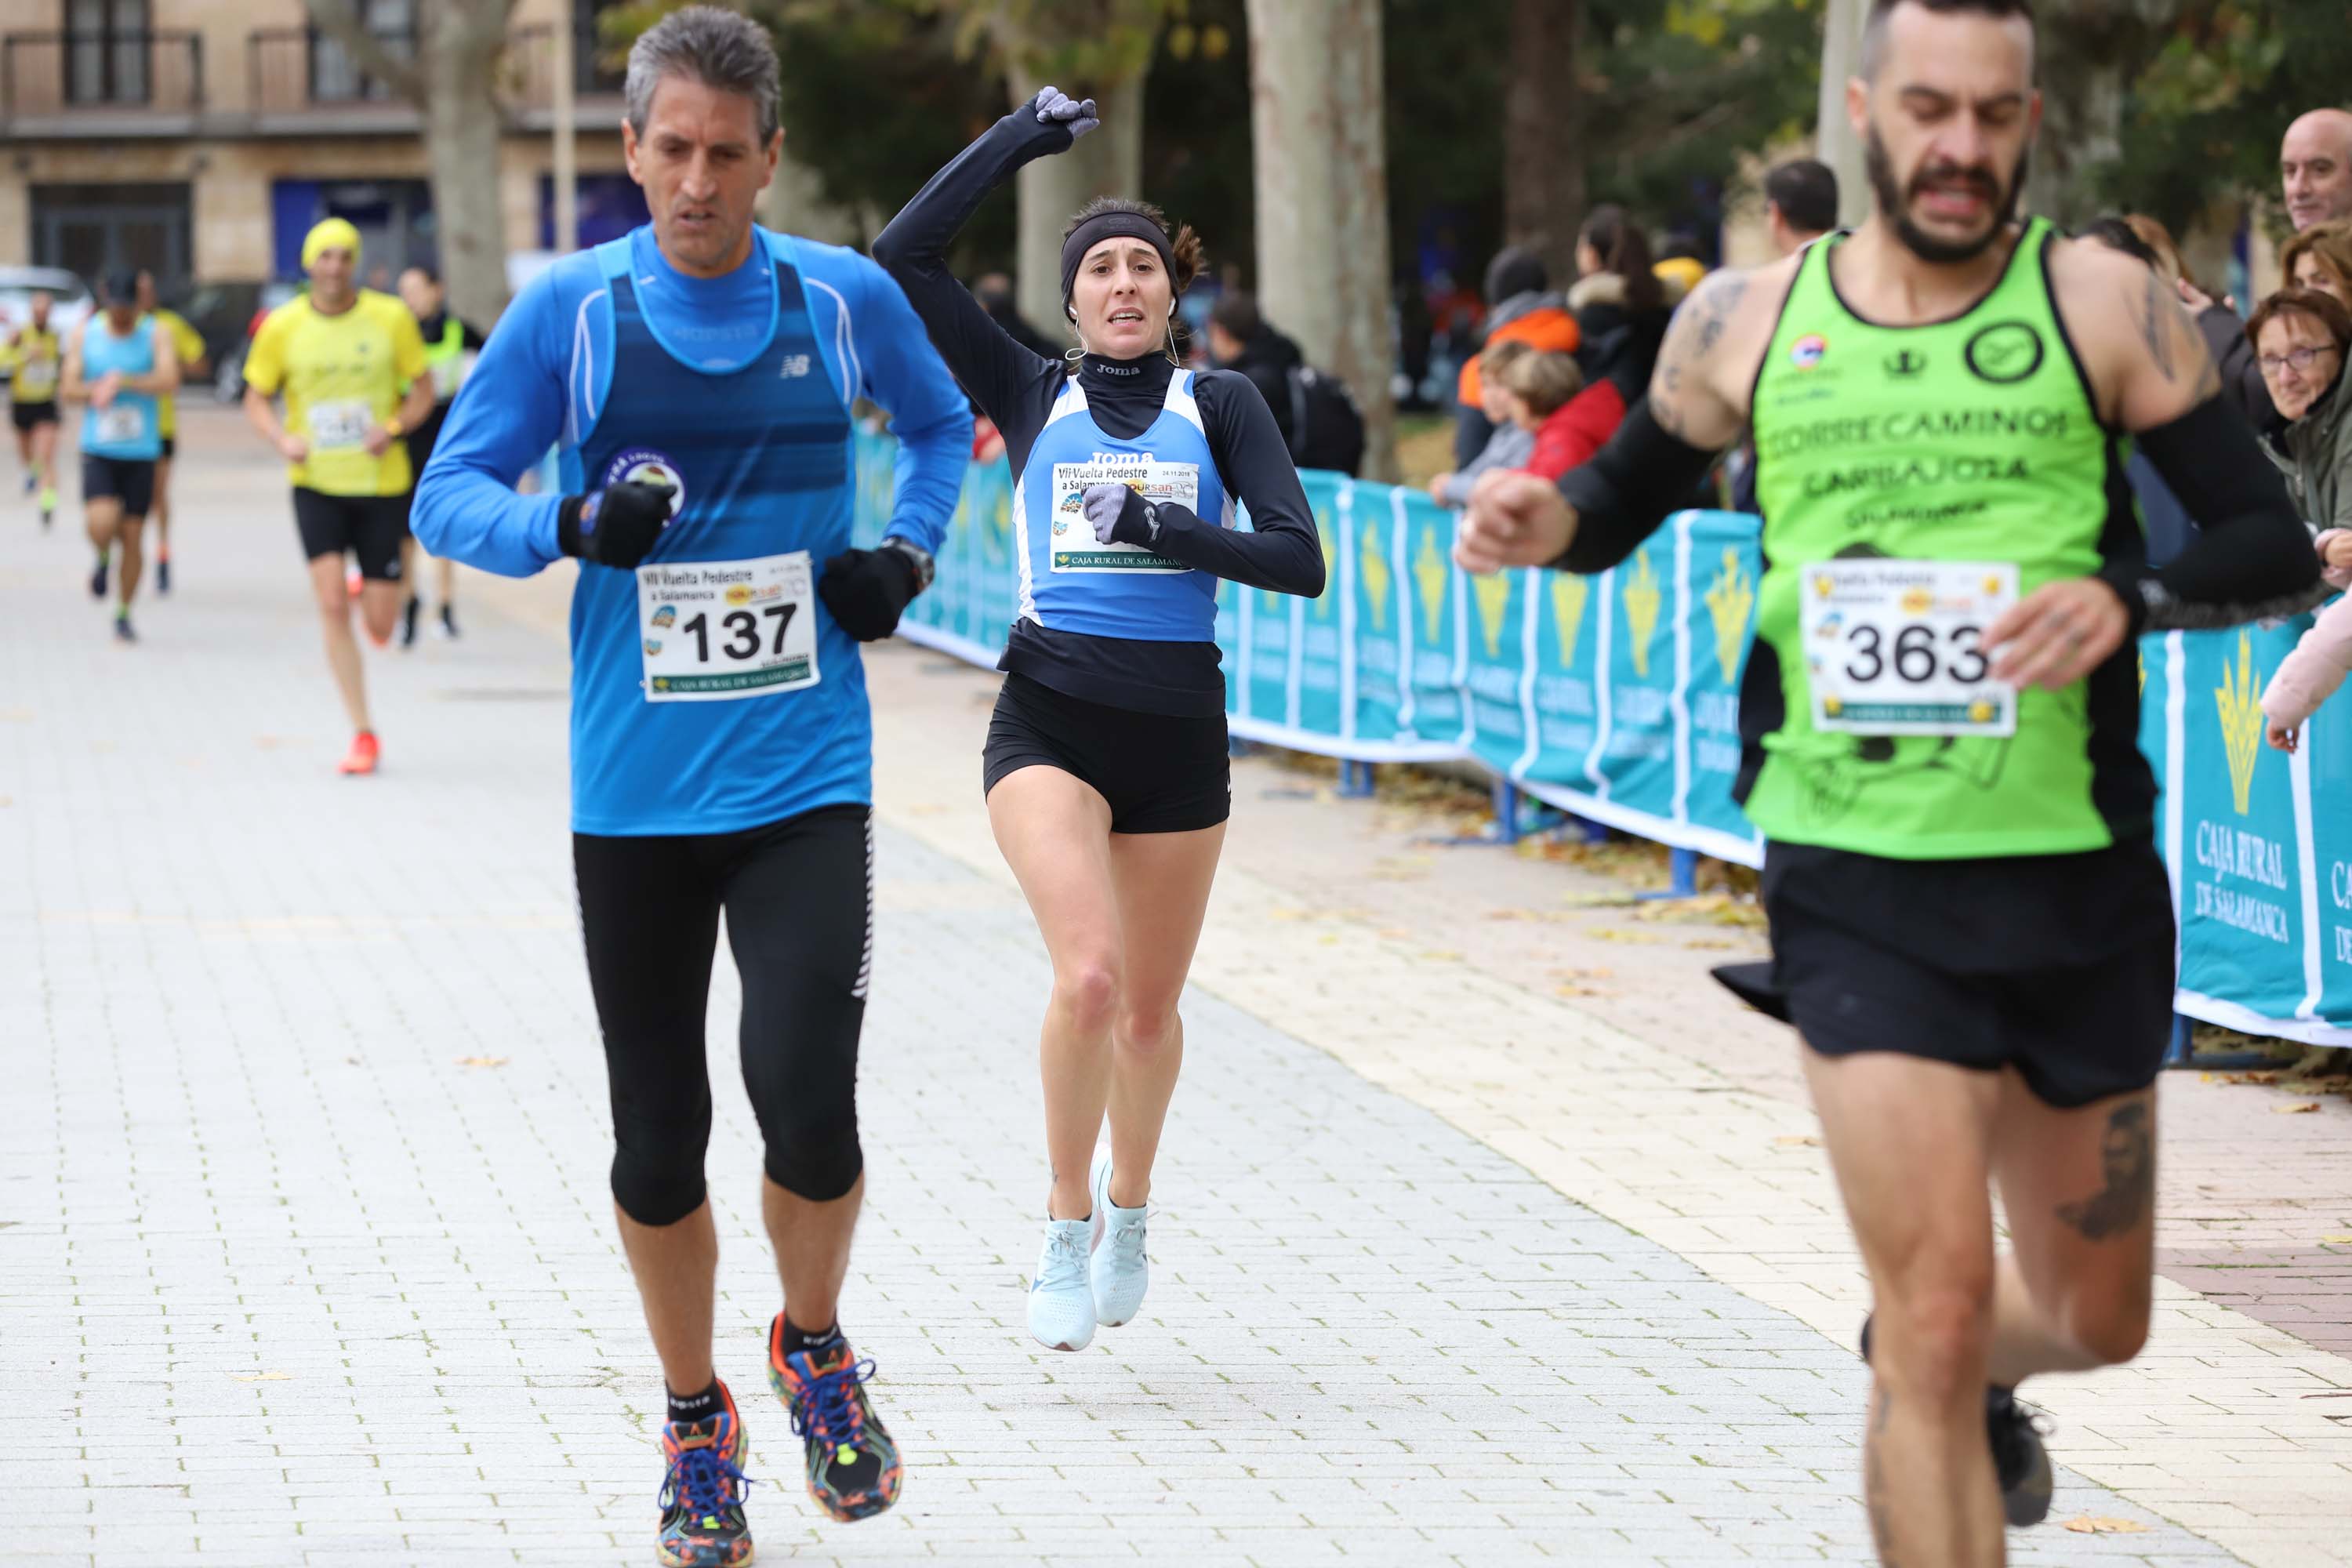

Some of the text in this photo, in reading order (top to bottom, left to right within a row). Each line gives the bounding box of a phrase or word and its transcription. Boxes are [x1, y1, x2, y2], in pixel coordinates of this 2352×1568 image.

[1097, 364, 1141, 376] Joma
[1073, 467, 1103, 478] Vuelta
[1106, 467, 1148, 478] Pedestre
[1072, 557, 1092, 565] CAJA
[1137, 557, 1181, 566] SALAMAN
[661, 571, 697, 585] Vuelta
[702, 570, 753, 583] Pedestre
[660, 590, 715, 601] Salamanca
[683, 603, 797, 662] 137
[1846, 624, 1989, 684] 363
[2196, 819, 2287, 891] CAJA RURAL
[2195, 880, 2289, 944] DE SALAMANCA
